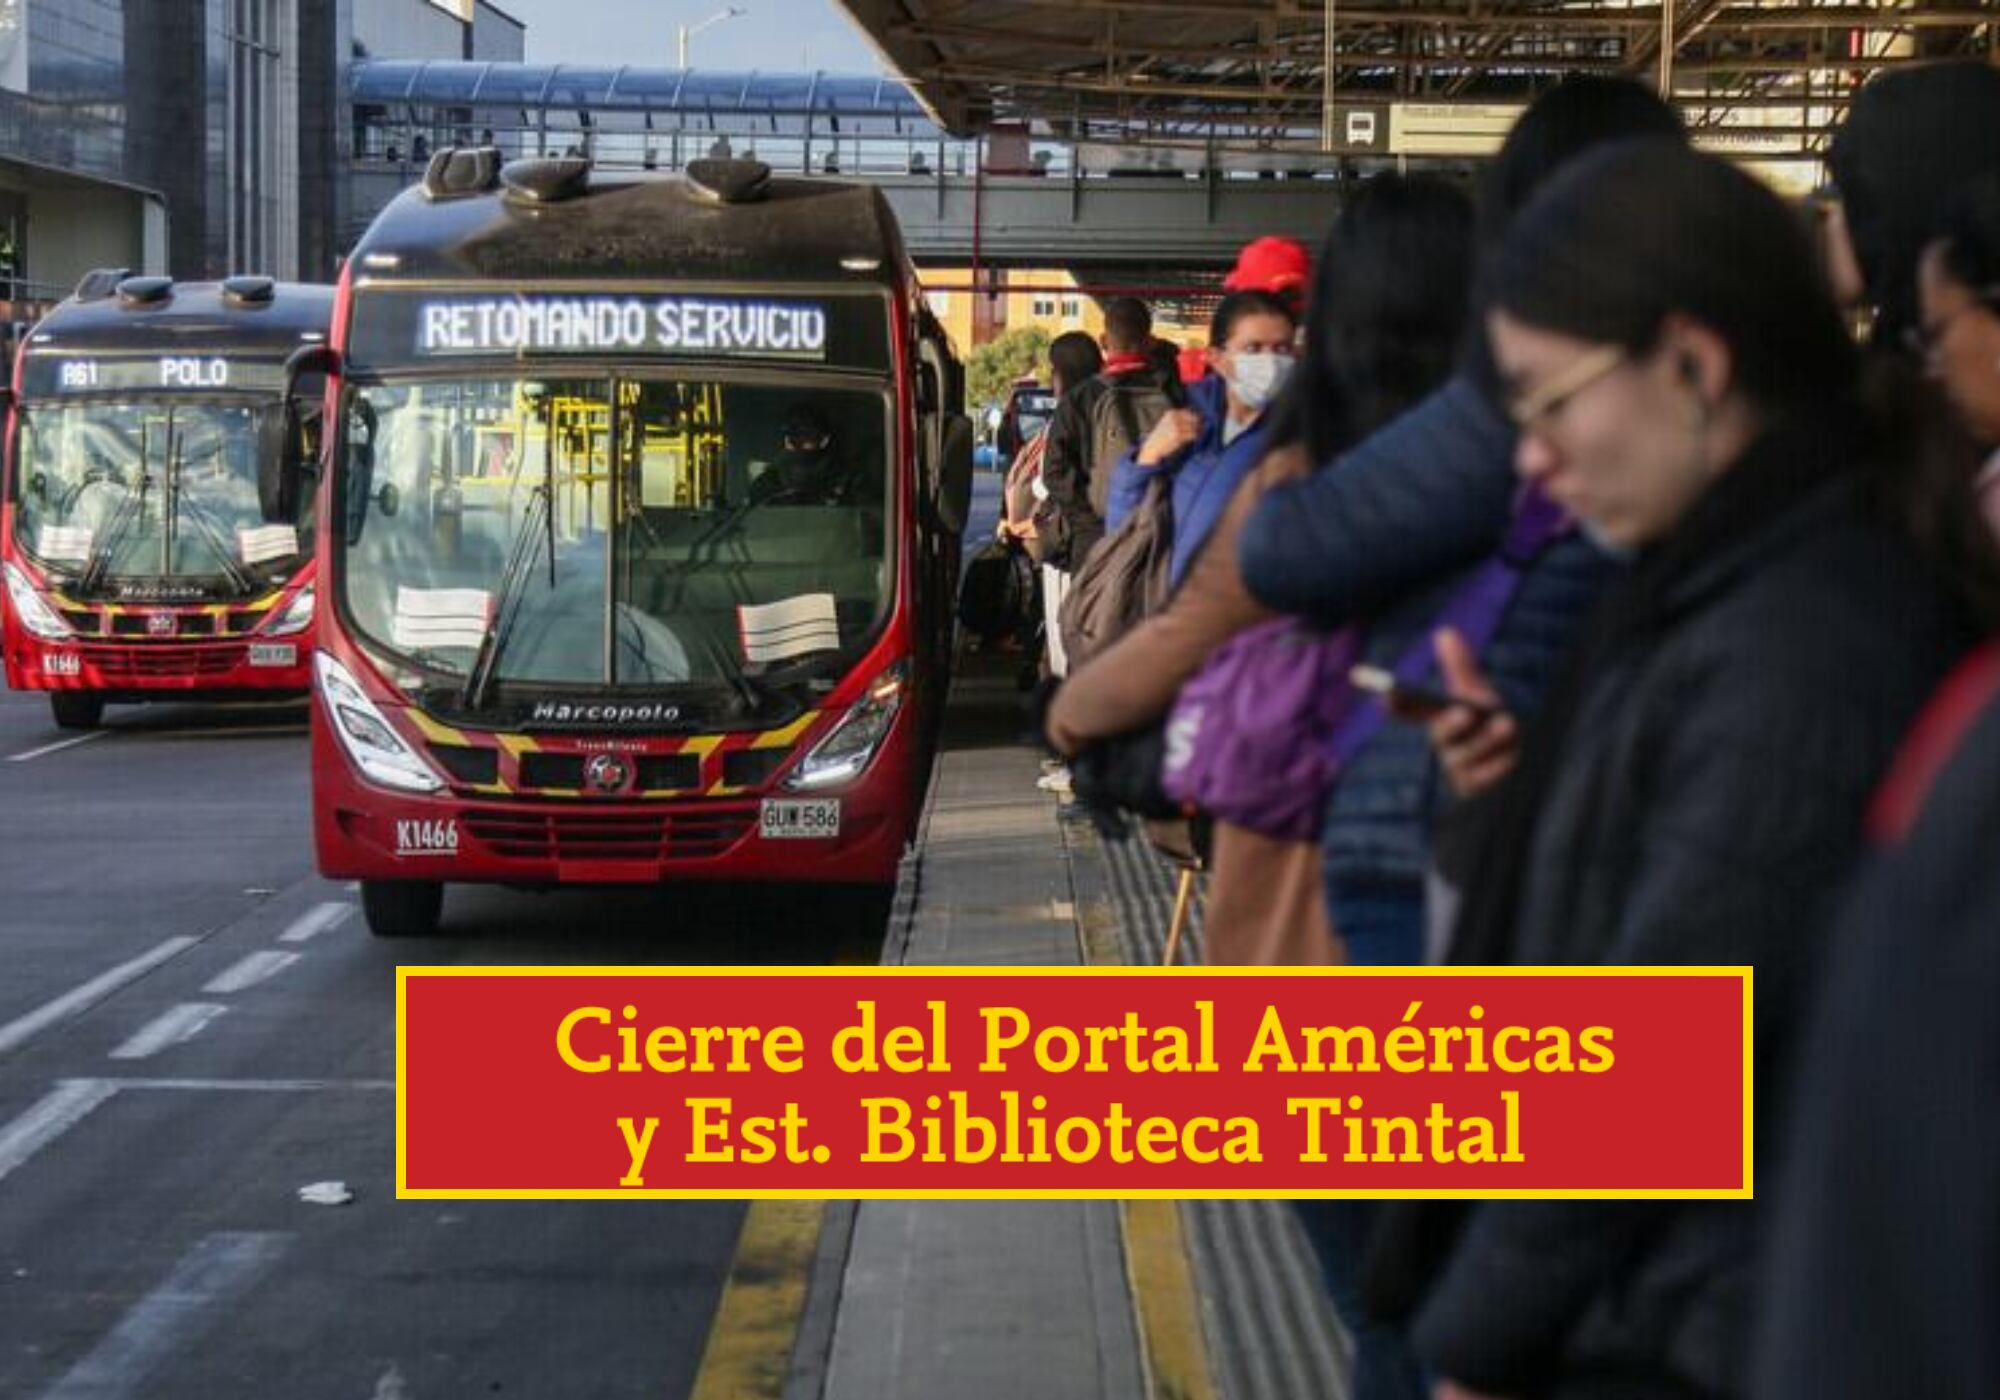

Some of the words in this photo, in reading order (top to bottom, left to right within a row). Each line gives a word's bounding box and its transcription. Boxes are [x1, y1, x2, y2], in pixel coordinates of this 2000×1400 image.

[423, 300, 646, 348] RETOMANDO
[655, 303, 825, 350] SERVICIO
[160, 357, 227, 386] POLO
[533, 702, 680, 722] Marcopolo
[803, 805, 837, 828] 586
[397, 820, 458, 849] K1466
